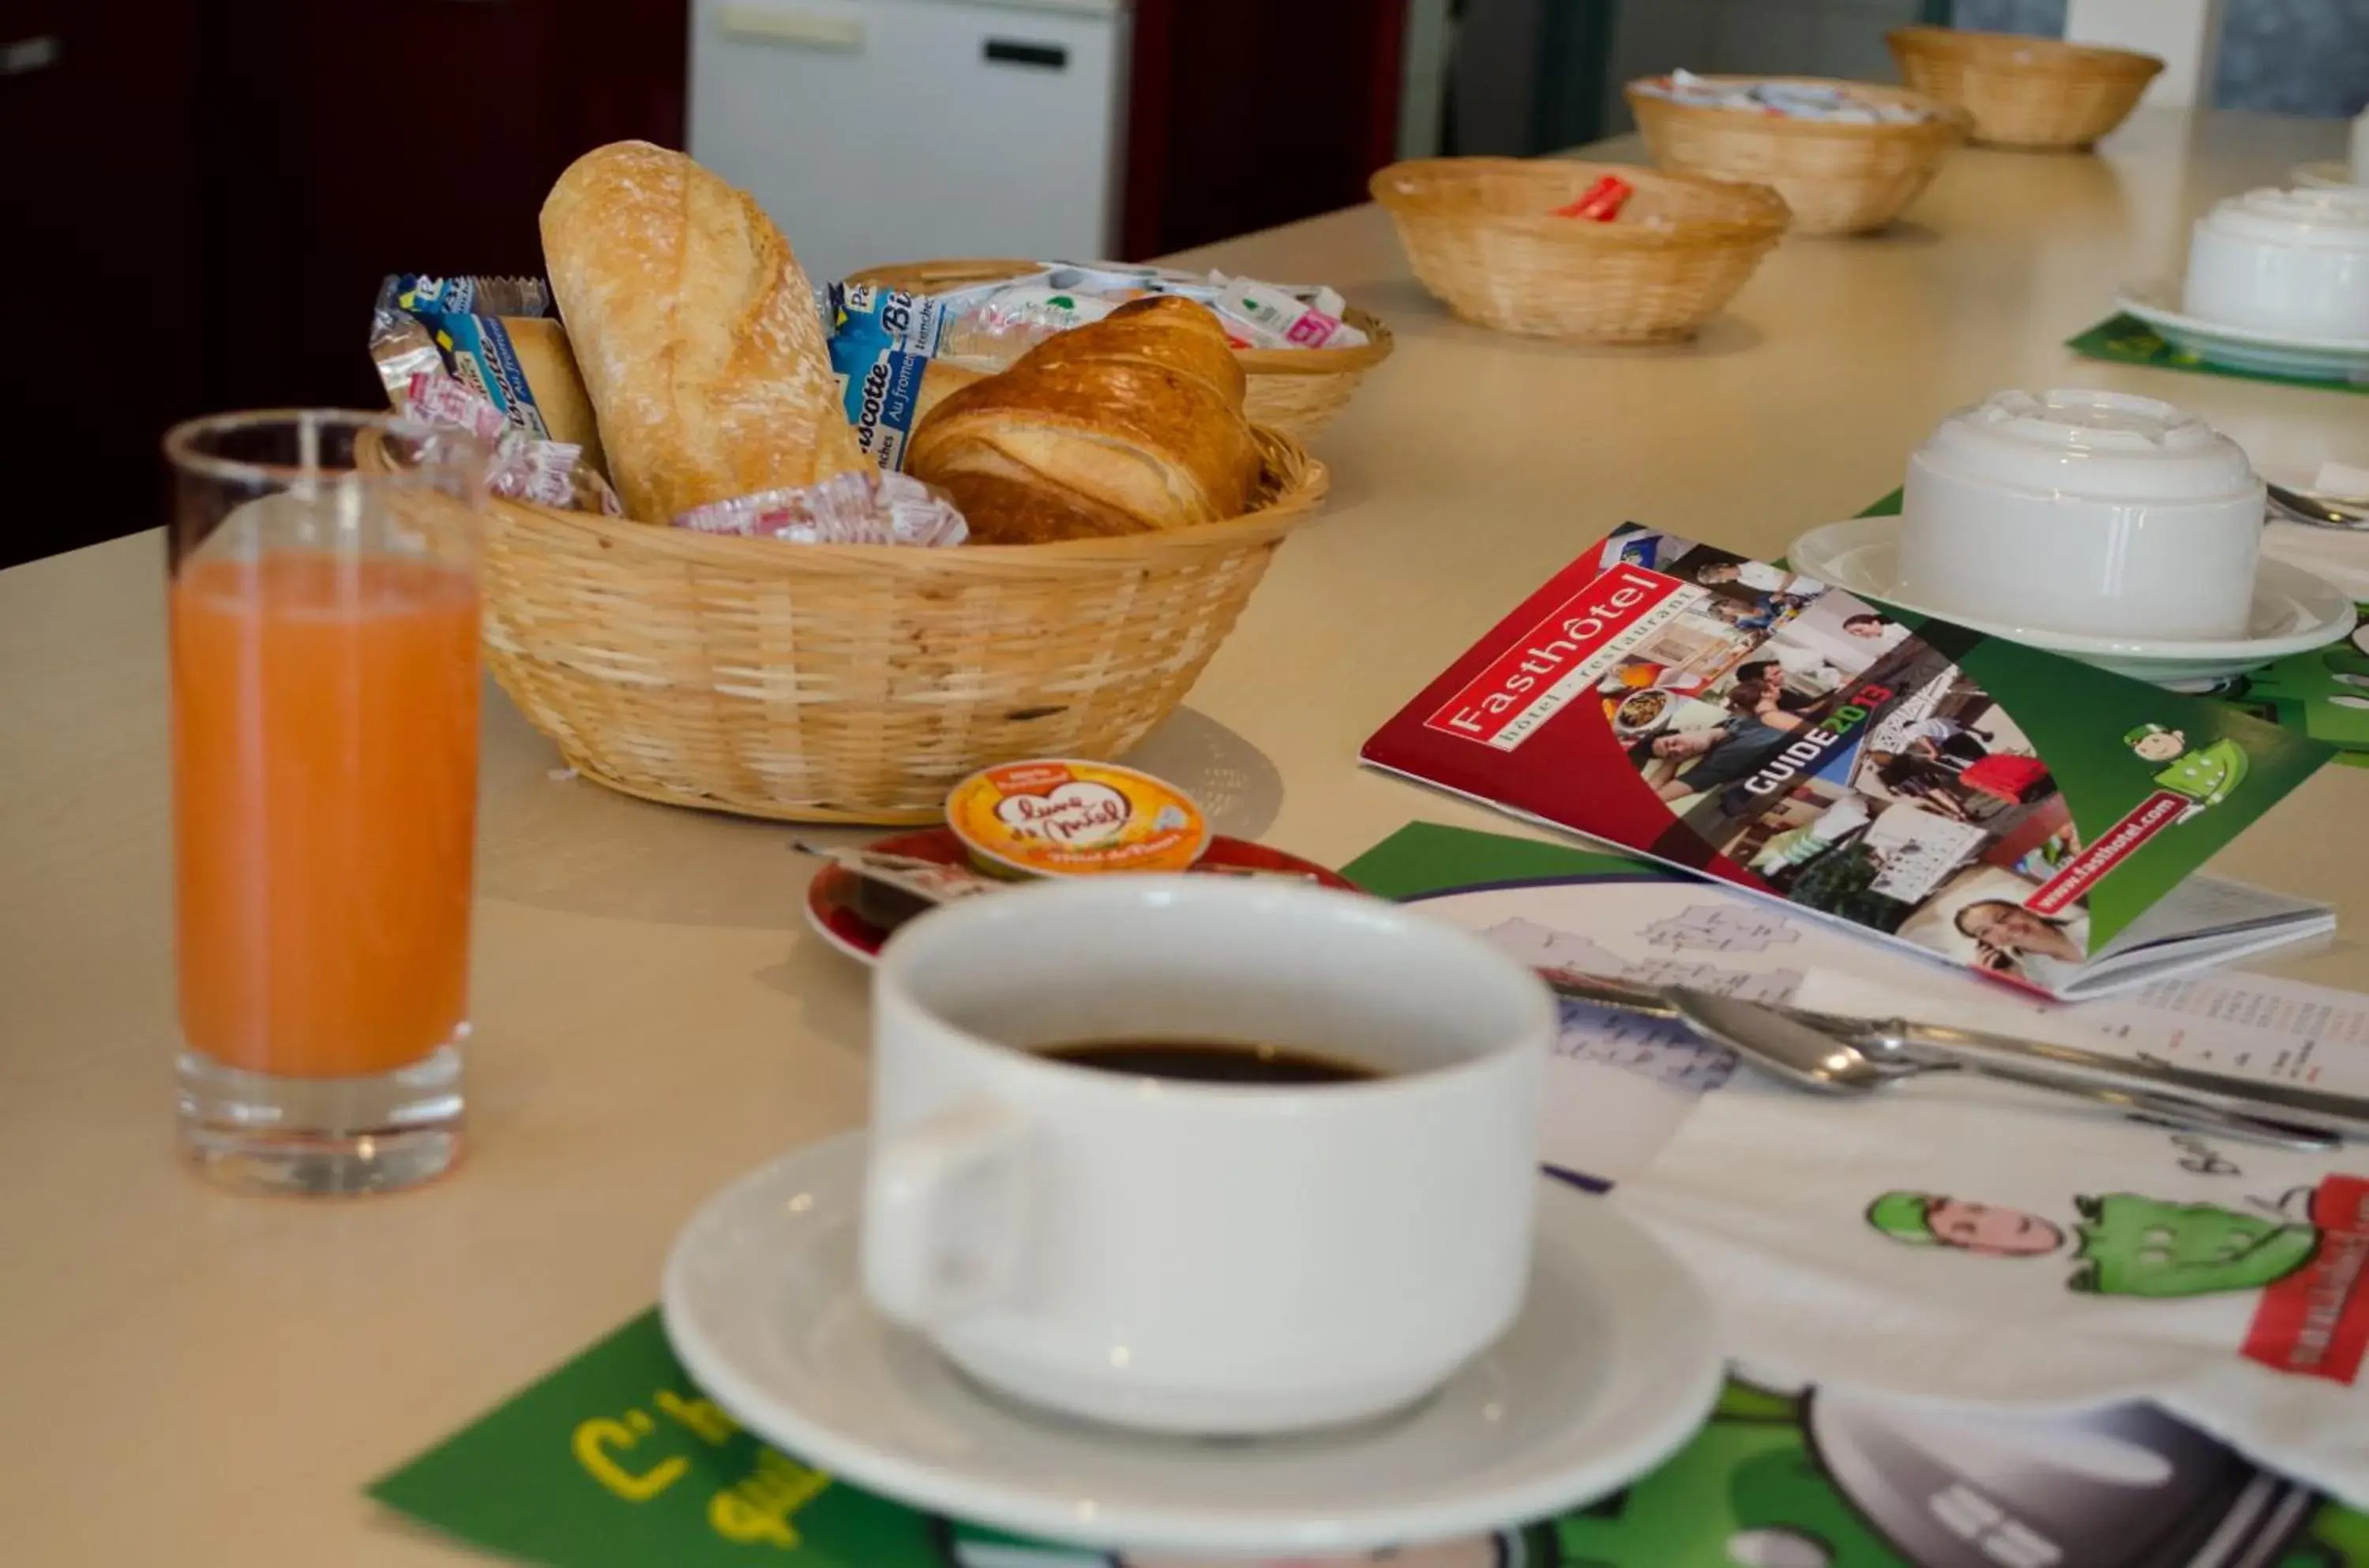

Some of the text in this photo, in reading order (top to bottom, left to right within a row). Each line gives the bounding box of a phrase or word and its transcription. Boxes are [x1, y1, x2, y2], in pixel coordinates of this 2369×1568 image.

[858, 363, 889, 455] iscotte
[888, 402, 904, 422] Au
[1448, 572, 1660, 733] Fasthôtel
[1497, 590, 1695, 743] hôtel restaurant
[2037, 799, 2177, 908] www.fasthotel.com
